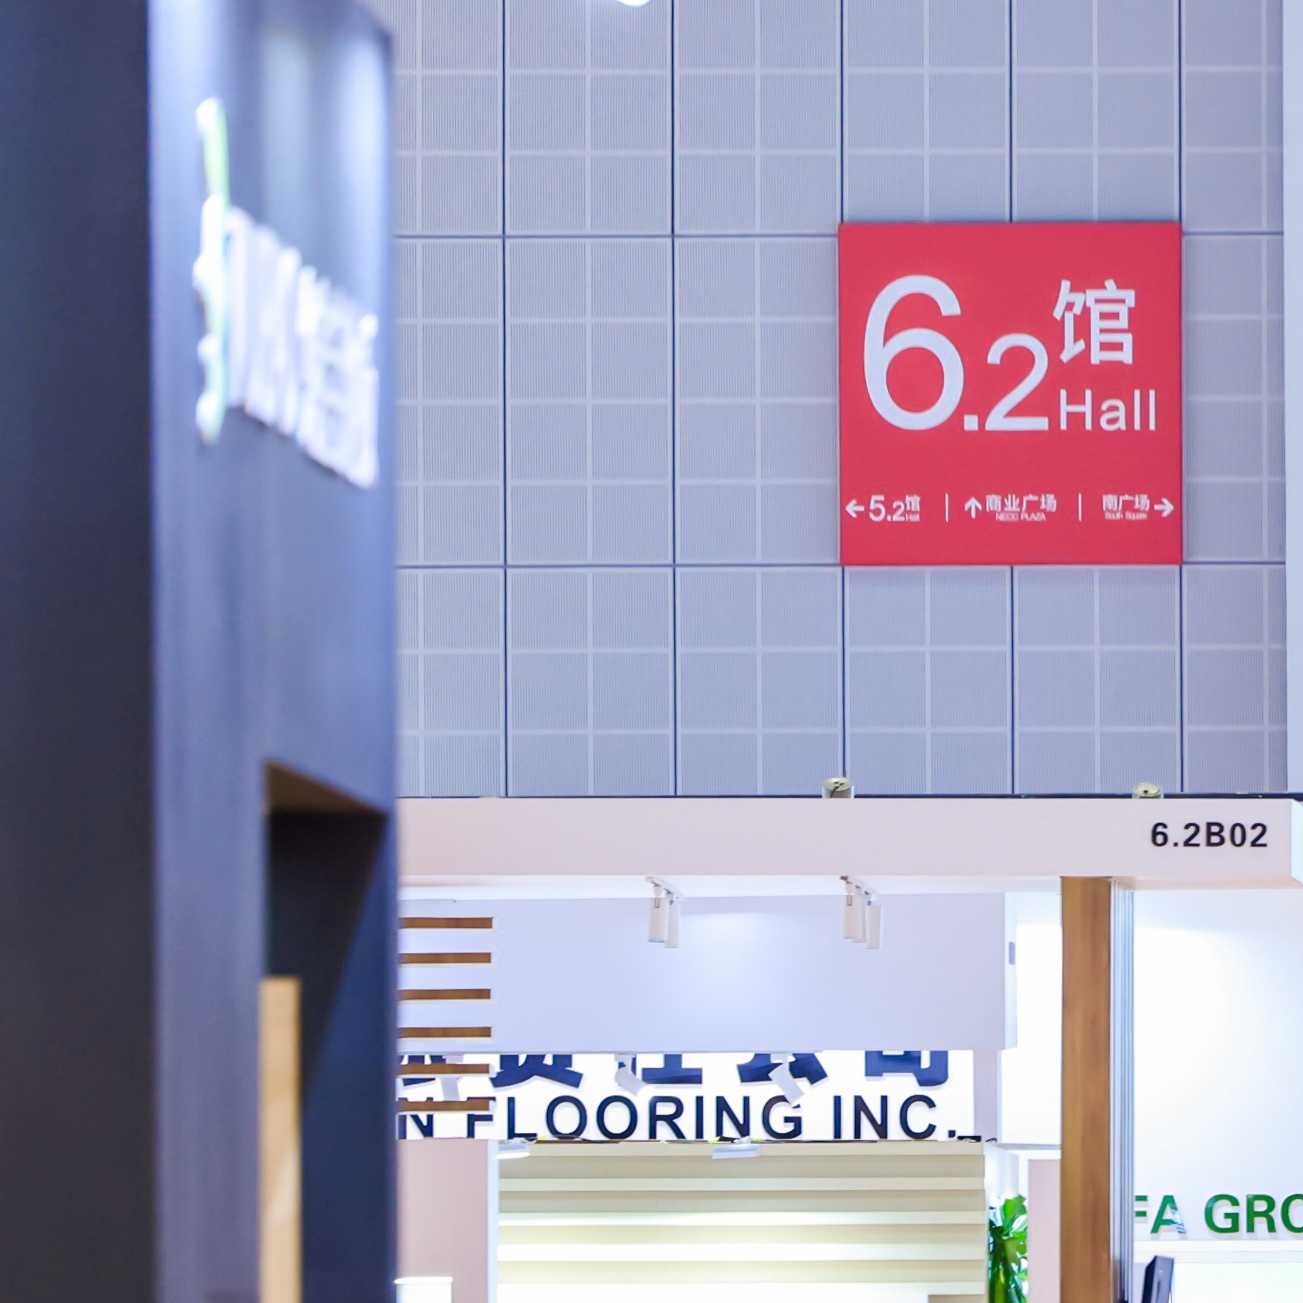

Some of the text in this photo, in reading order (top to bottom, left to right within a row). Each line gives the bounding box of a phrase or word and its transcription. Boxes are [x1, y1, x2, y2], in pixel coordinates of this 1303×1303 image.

[1052, 279, 1135, 364] 馆
[863, 275, 1049, 431] 6.2
[1059, 389, 1156, 431] Hall
[985, 494, 1057, 512] 商业广场
[1151, 822, 1268, 848] 6.2B02
[467, 1094, 802, 1140] FLOORING
[833, 1094, 956, 1140] INC.
